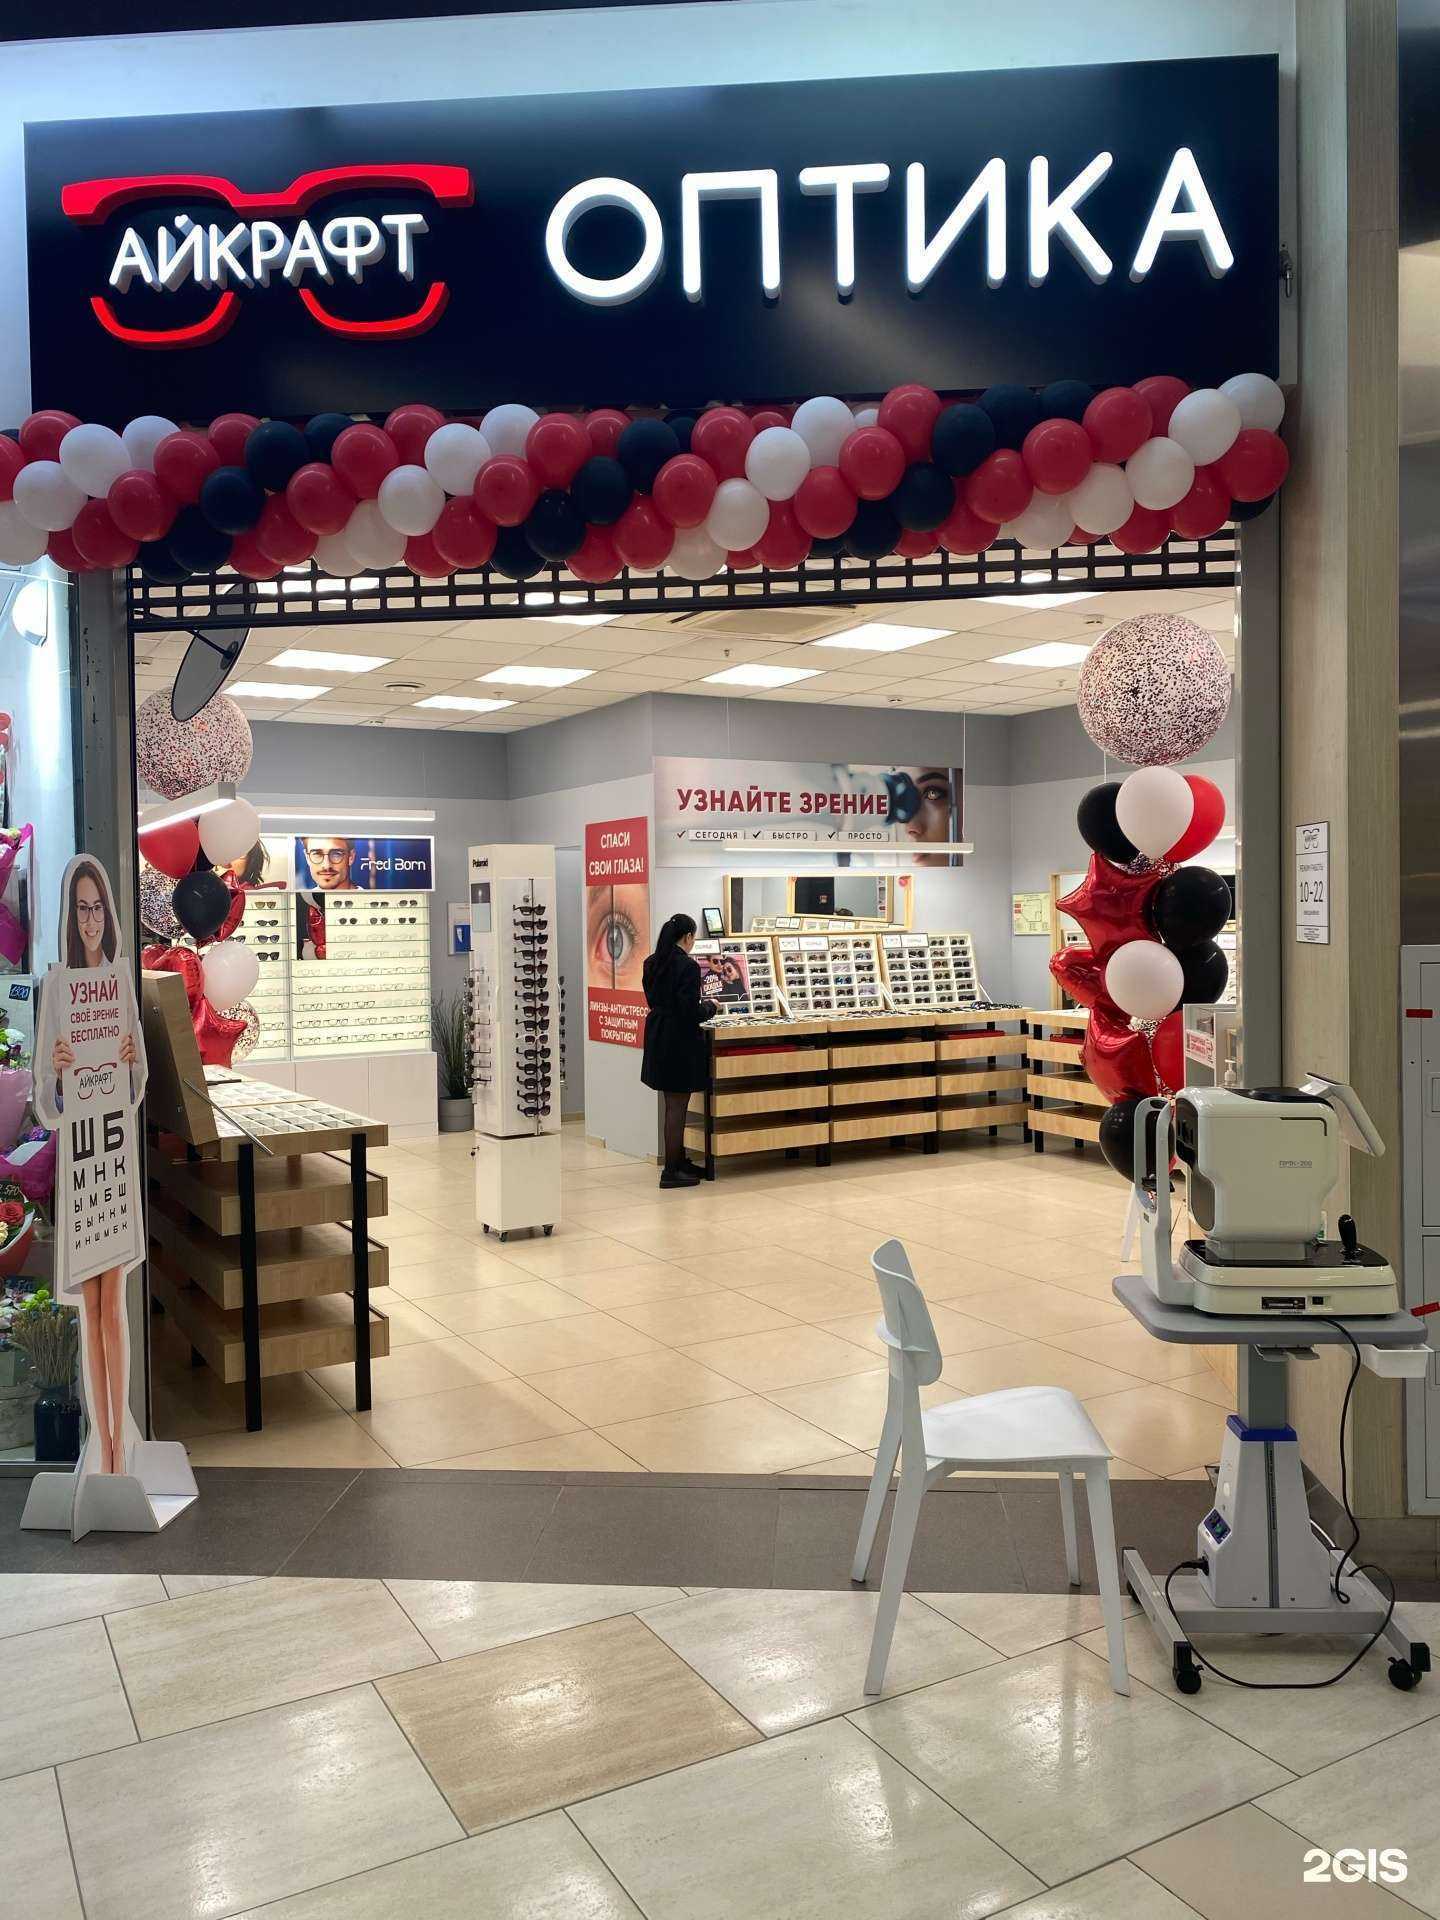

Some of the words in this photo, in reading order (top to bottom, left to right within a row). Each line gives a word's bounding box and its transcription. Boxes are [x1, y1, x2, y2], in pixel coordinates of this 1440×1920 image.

[544, 147, 1234, 306] ОПТИКА
[109, 213, 427, 292] АЙКРАФТ
[677, 785, 791, 813] УЗНАЙТЕ
[800, 792, 888, 814] ЗРЕНИЕ
[601, 831, 631, 849] СПАСИ
[695, 831, 738, 840] СЕГОДНЯ
[772, 831, 808, 840] БЫСТРО
[848, 831, 882, 840] ПРОСТО
[360, 857, 391, 871] Fred
[395, 858, 426, 871] Born
[589, 860, 612, 876] СВОИ
[614, 857, 644, 874] ГЛАЗА!
[1300, 880, 1323, 903] 10-22
[69, 974, 119, 1005] УЗНАЙ
[70, 1008, 90, 1024] СВОЁ
[93, 1007, 119, 1021] ЗРЕНИЕ
[605, 1016, 638, 1030] ЗАЩИТНЫМ
[71, 1025, 120, 1044] БЕСПЛАТНО
[601, 1028, 637, 1043] ПОКРЫТИЕМ
[79, 1072, 113, 1089] АЙКРАФТ
